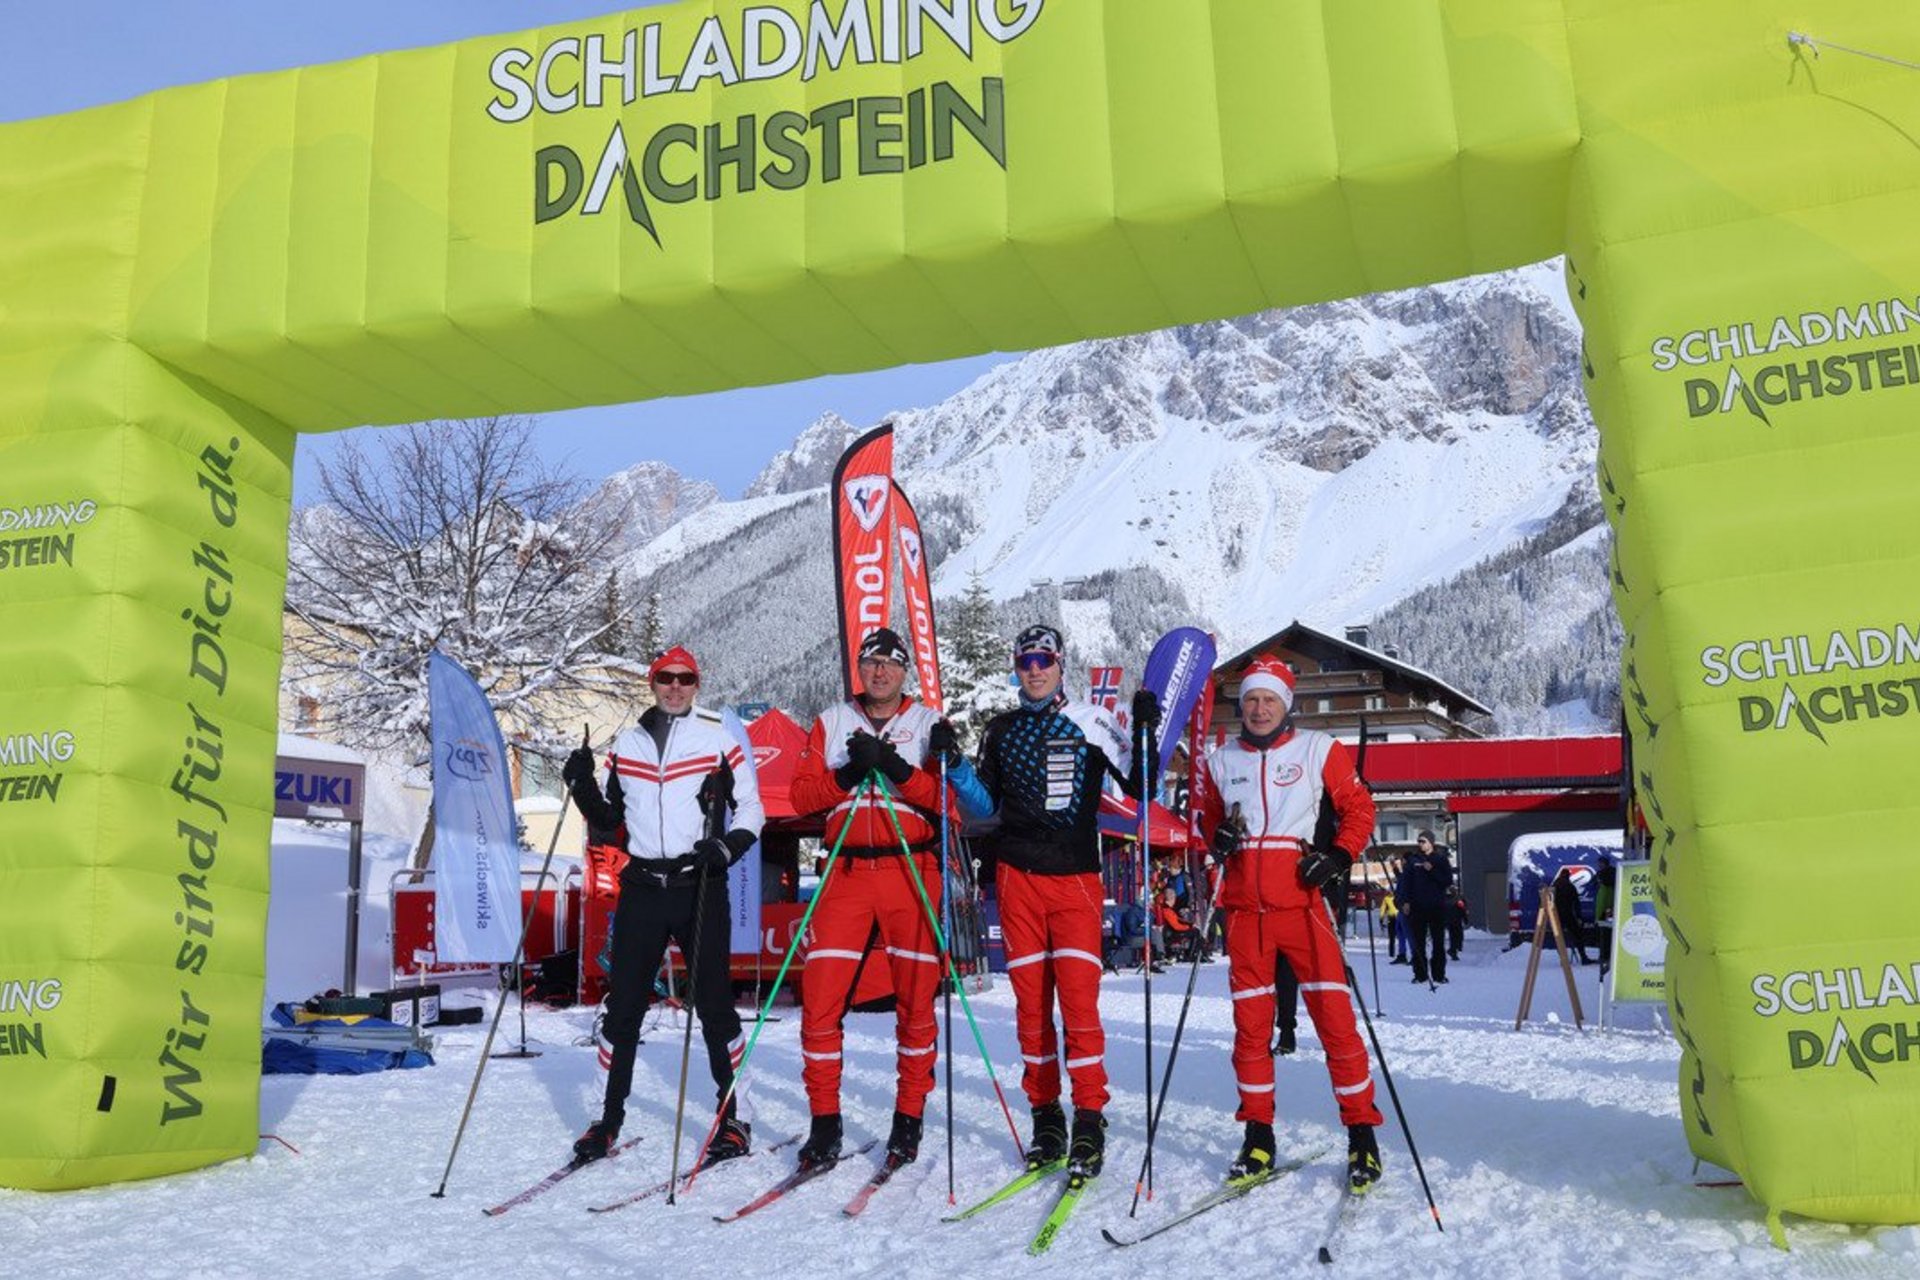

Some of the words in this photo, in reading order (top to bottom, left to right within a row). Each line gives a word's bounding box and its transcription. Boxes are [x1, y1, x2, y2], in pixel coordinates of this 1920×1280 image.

[485, 0, 1044, 123] SCHLADMING
[535, 76, 1006, 250] DACHSTEIN
[1684, 343, 1920, 428] DACHSTEI
[196, 436, 241, 529] da.
[181, 541, 235, 697] Dich
[170, 701, 228, 823] für
[274, 771, 352, 805] ZUKI
[174, 819, 219, 976] sind
[1751, 962, 1920, 1018] SCHLA
[158, 989, 211, 1127] Wir
